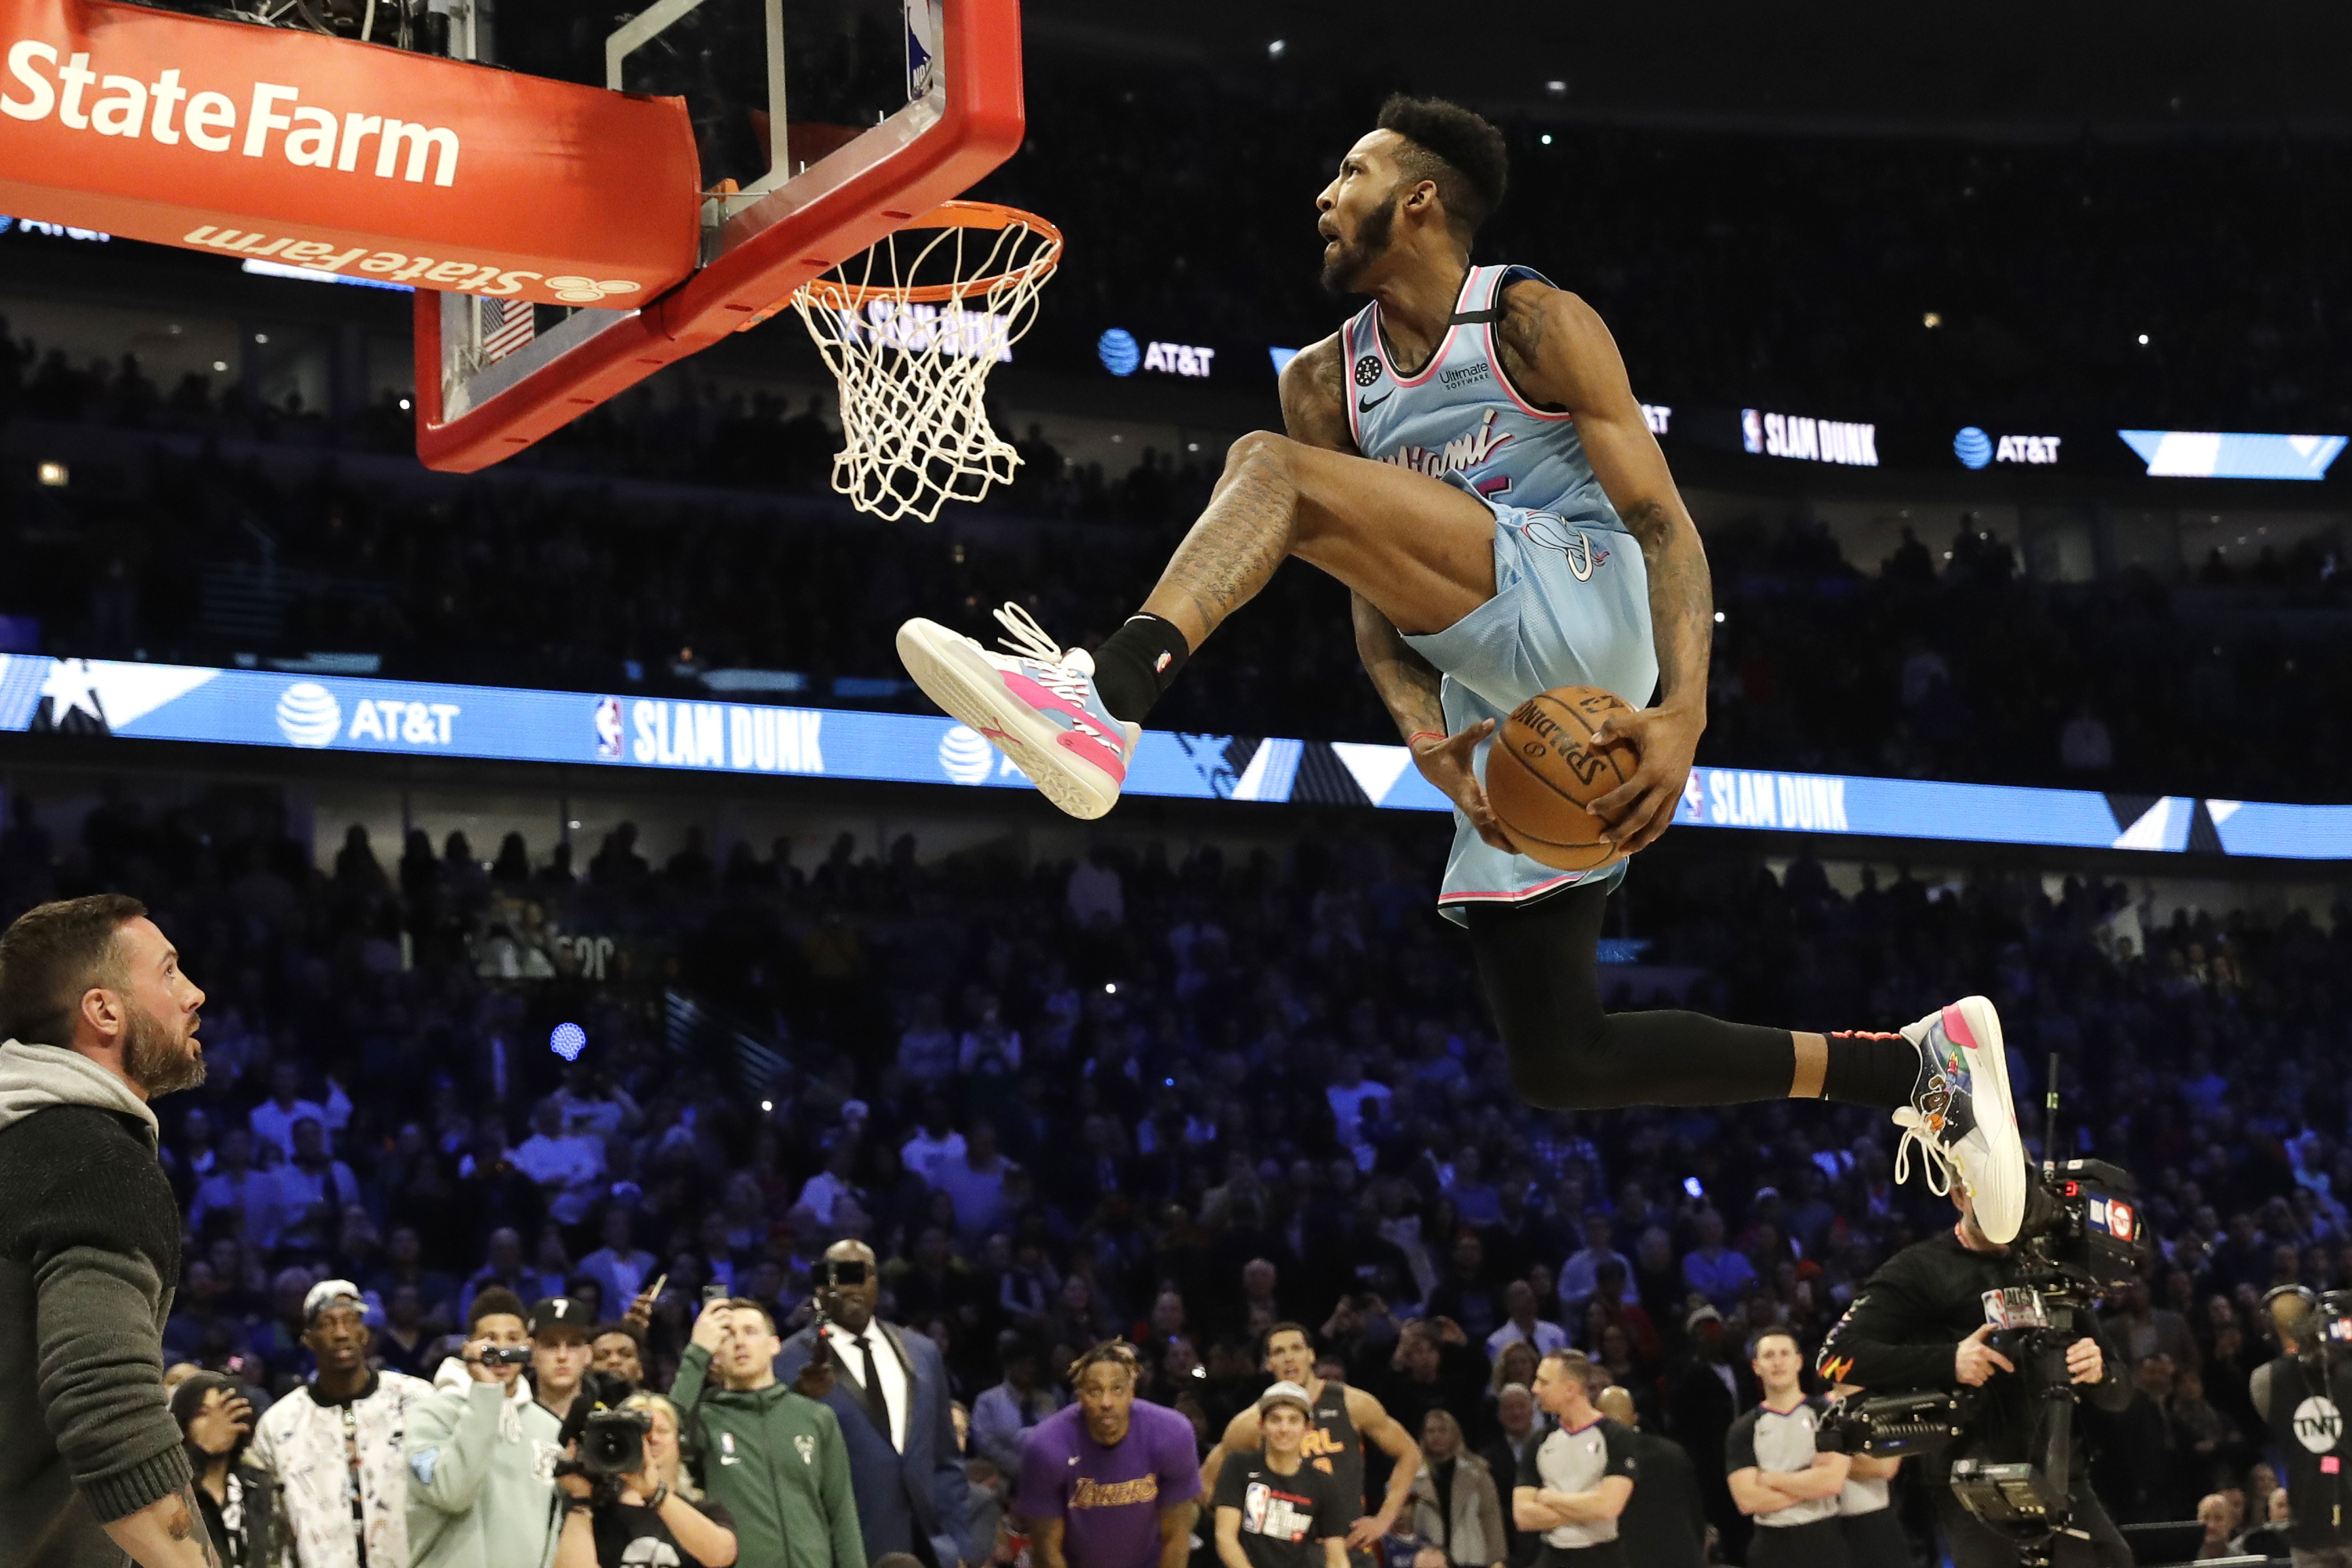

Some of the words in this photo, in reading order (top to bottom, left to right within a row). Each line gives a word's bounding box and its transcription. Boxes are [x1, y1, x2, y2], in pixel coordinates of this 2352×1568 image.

[1144, 341, 1214, 377] AT&T
[1439, 362, 1489, 384] Ultimate
[1446, 374, 1490, 390] SOFTWARE
[1764, 412, 1818, 460] SLAM
[1818, 419, 1879, 466] DUNK
[1997, 435, 2061, 464] AT&T
[348, 698, 462, 745] AT&T
[633, 700, 725, 767] SLAM
[730, 708, 824, 774] DUNK
[1511, 698, 1608, 786] SPALDING
[1709, 770, 1777, 826] SLAM
[1778, 776, 1849, 832] DUNK
[552, 1298, 570, 1319] 7
[1300, 1427, 1345, 1458] RL
[2293, 1415, 2340, 1439] TNT
